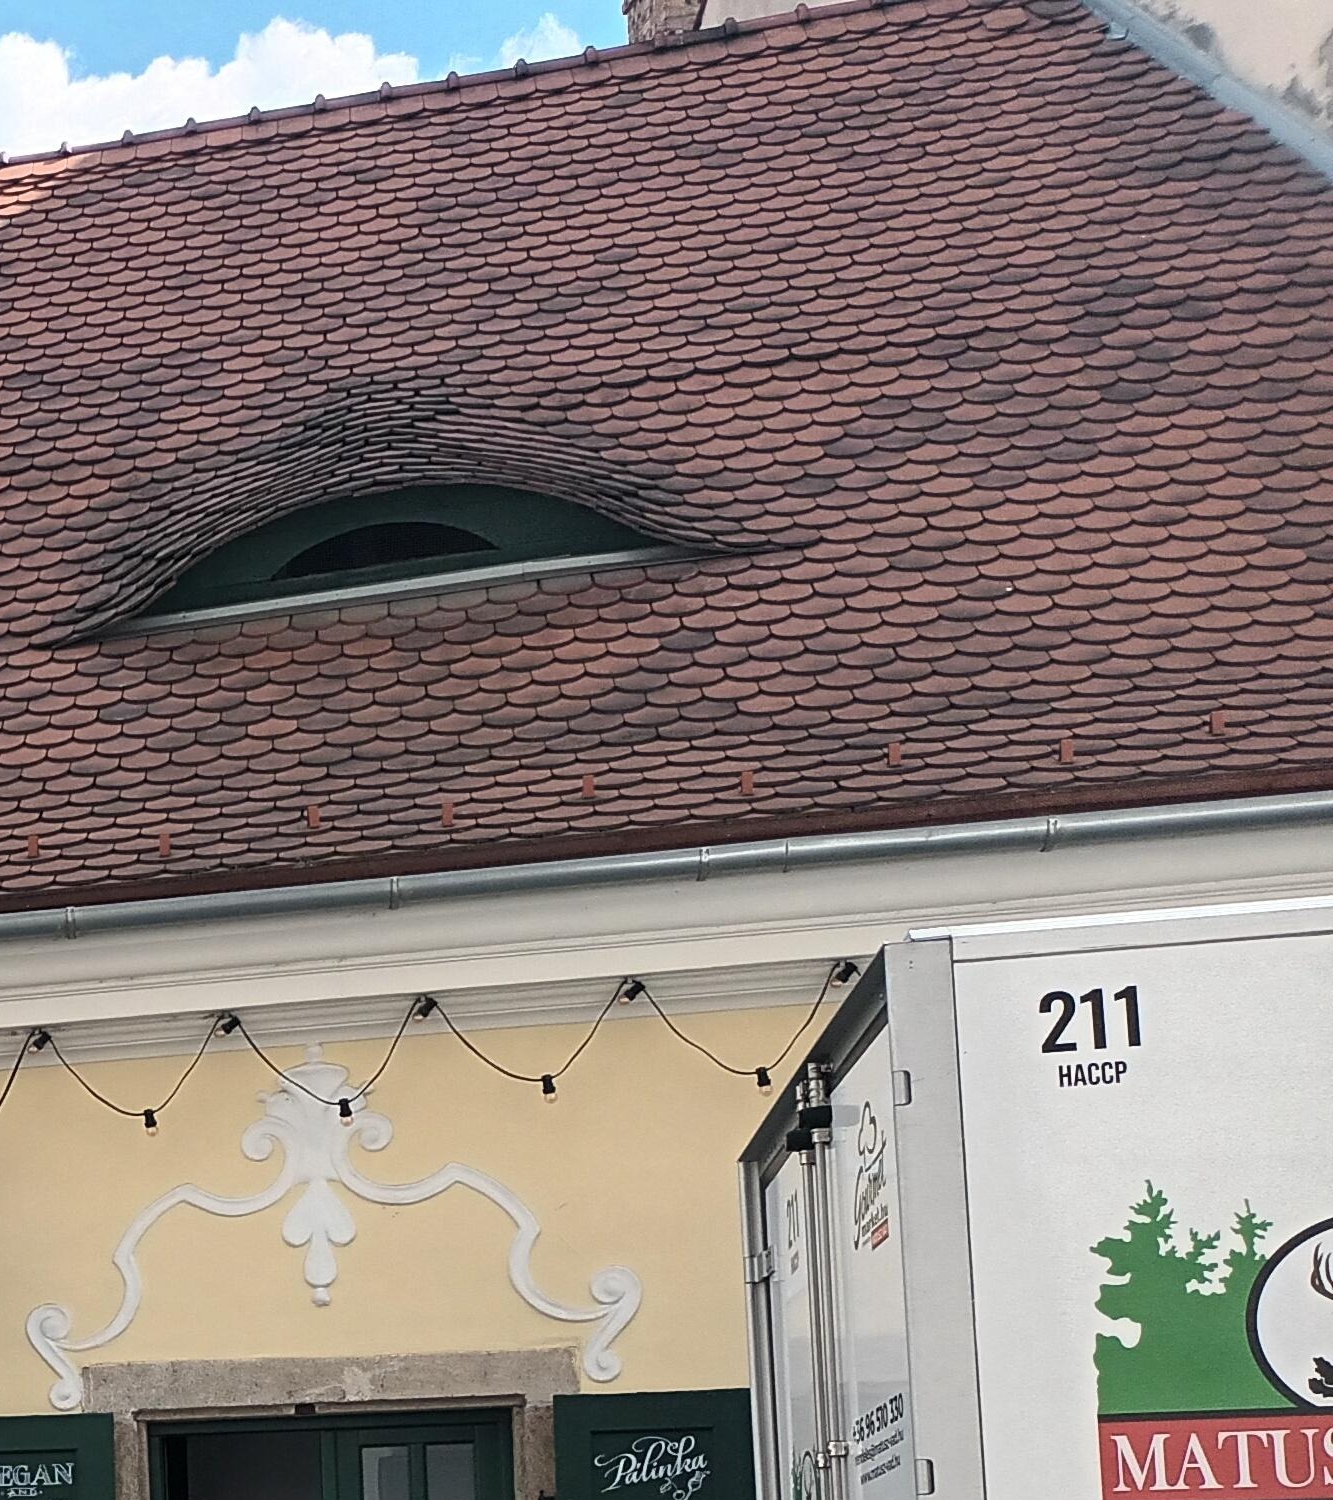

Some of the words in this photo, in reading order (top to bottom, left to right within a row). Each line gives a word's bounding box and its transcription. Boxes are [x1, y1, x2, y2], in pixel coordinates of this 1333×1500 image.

[1038, 985, 1141, 1053] 211
[1058, 1060, 1128, 1088] HACCP
[865, 1410, 876, 1438] 96
[889, 1392, 904, 1424] 330
[594, 1435, 709, 1493] Pálinka
[8, 1488, 38, 1498] AND
